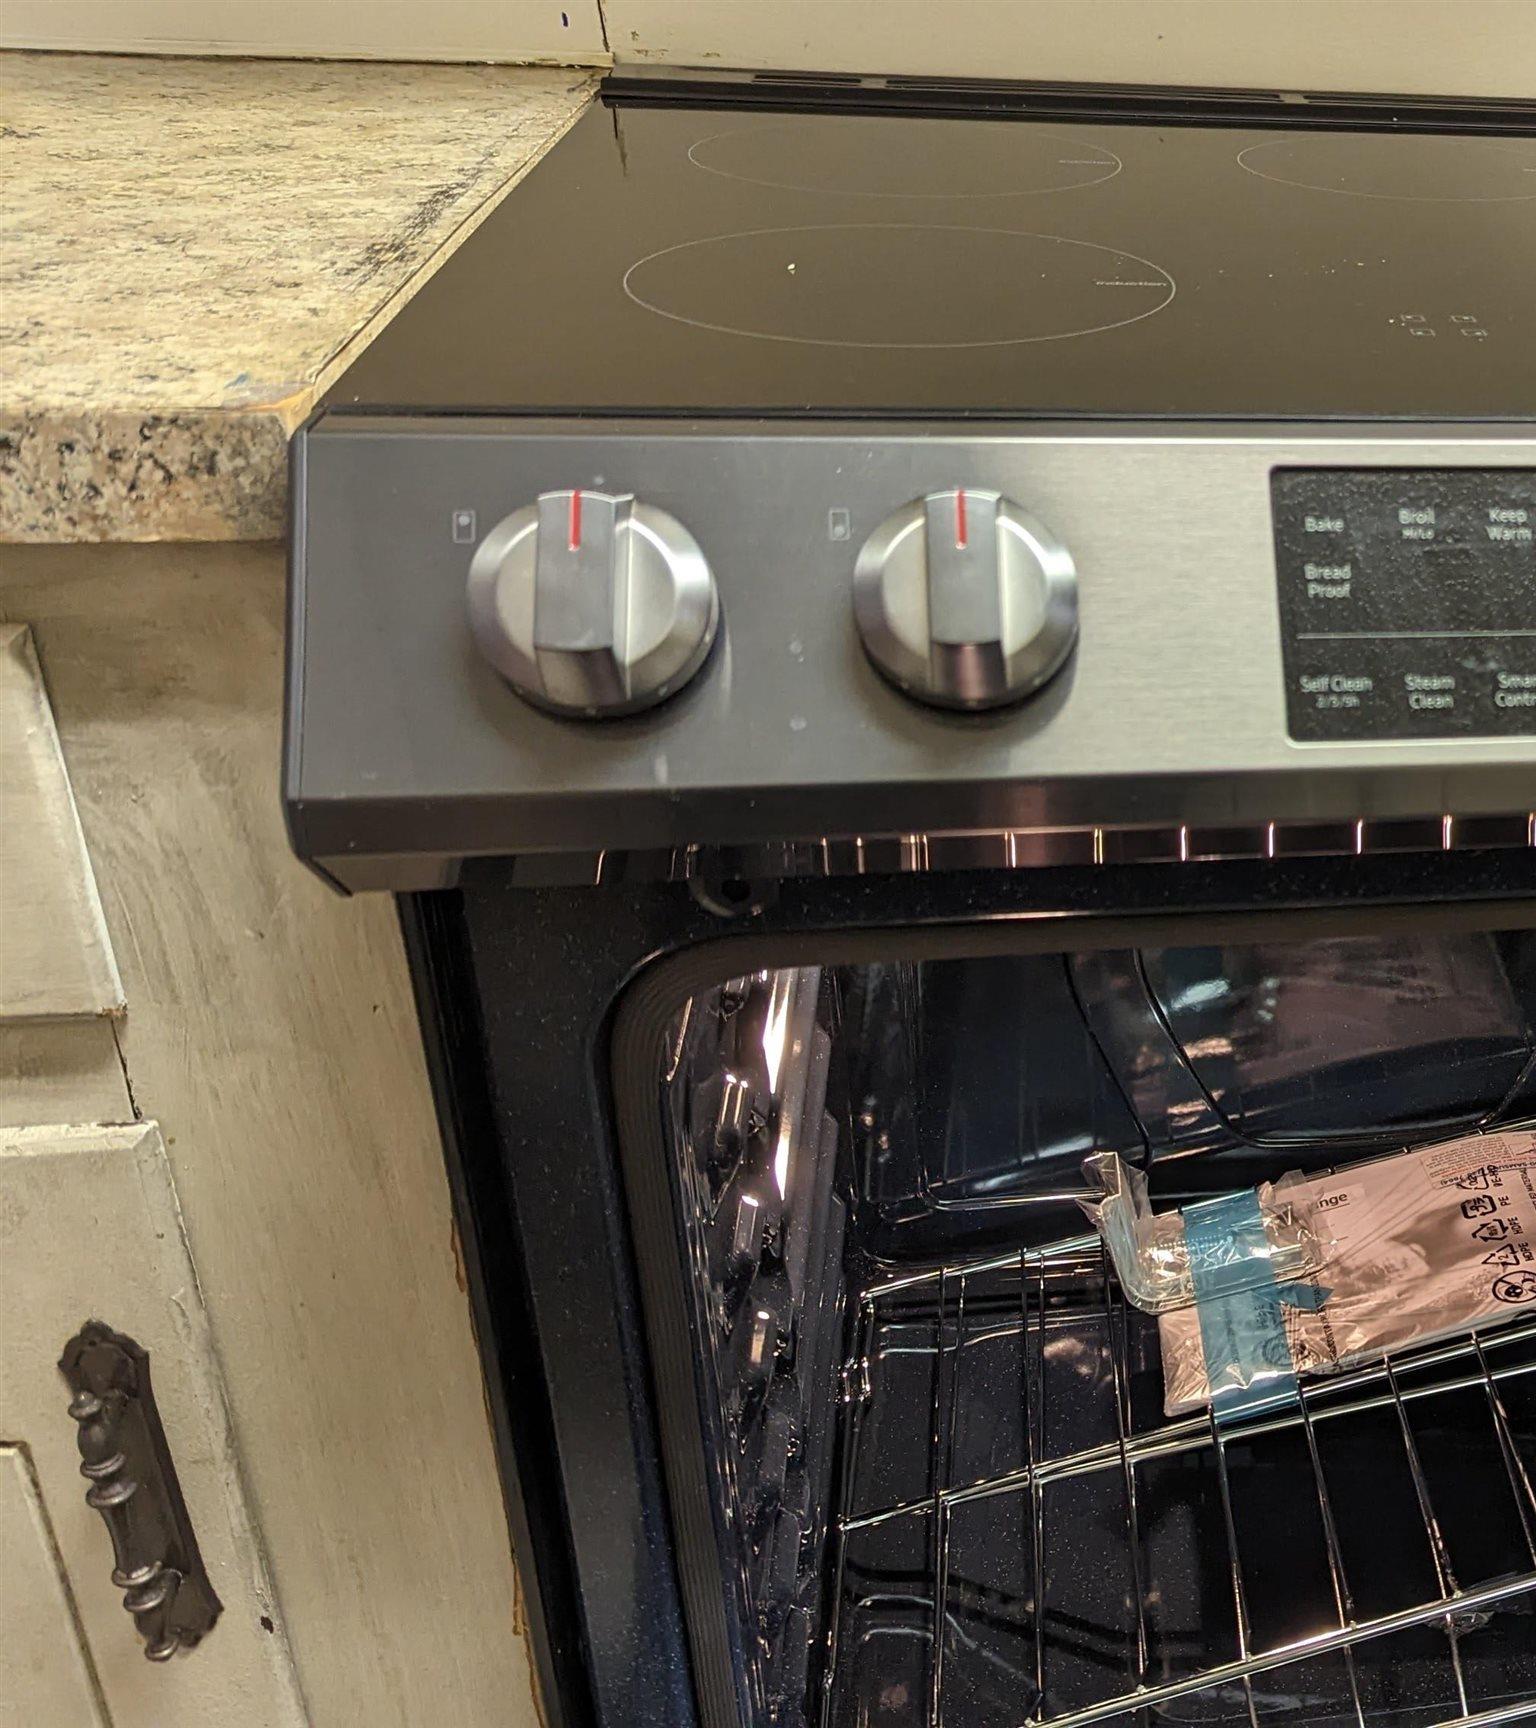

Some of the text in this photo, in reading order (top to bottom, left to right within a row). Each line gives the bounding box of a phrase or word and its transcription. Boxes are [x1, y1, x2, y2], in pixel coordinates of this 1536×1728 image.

[1399, 507, 1435, 524] Broil
[1489, 508, 1528, 525] Keep
[1304, 516, 1344, 533] Bake
[1487, 526, 1532, 542] Warm
[1304, 563, 1351, 580] Bread
[1307, 582, 1351, 598] Proof
[1299, 674, 1373, 693] Self Clean
[1405, 673, 1455, 691] Steam
[1409, 693, 1455, 710] Clean
[1498, 1195, 1511, 1207] PE
[1518, 1241, 1534, 1262] HDPE
